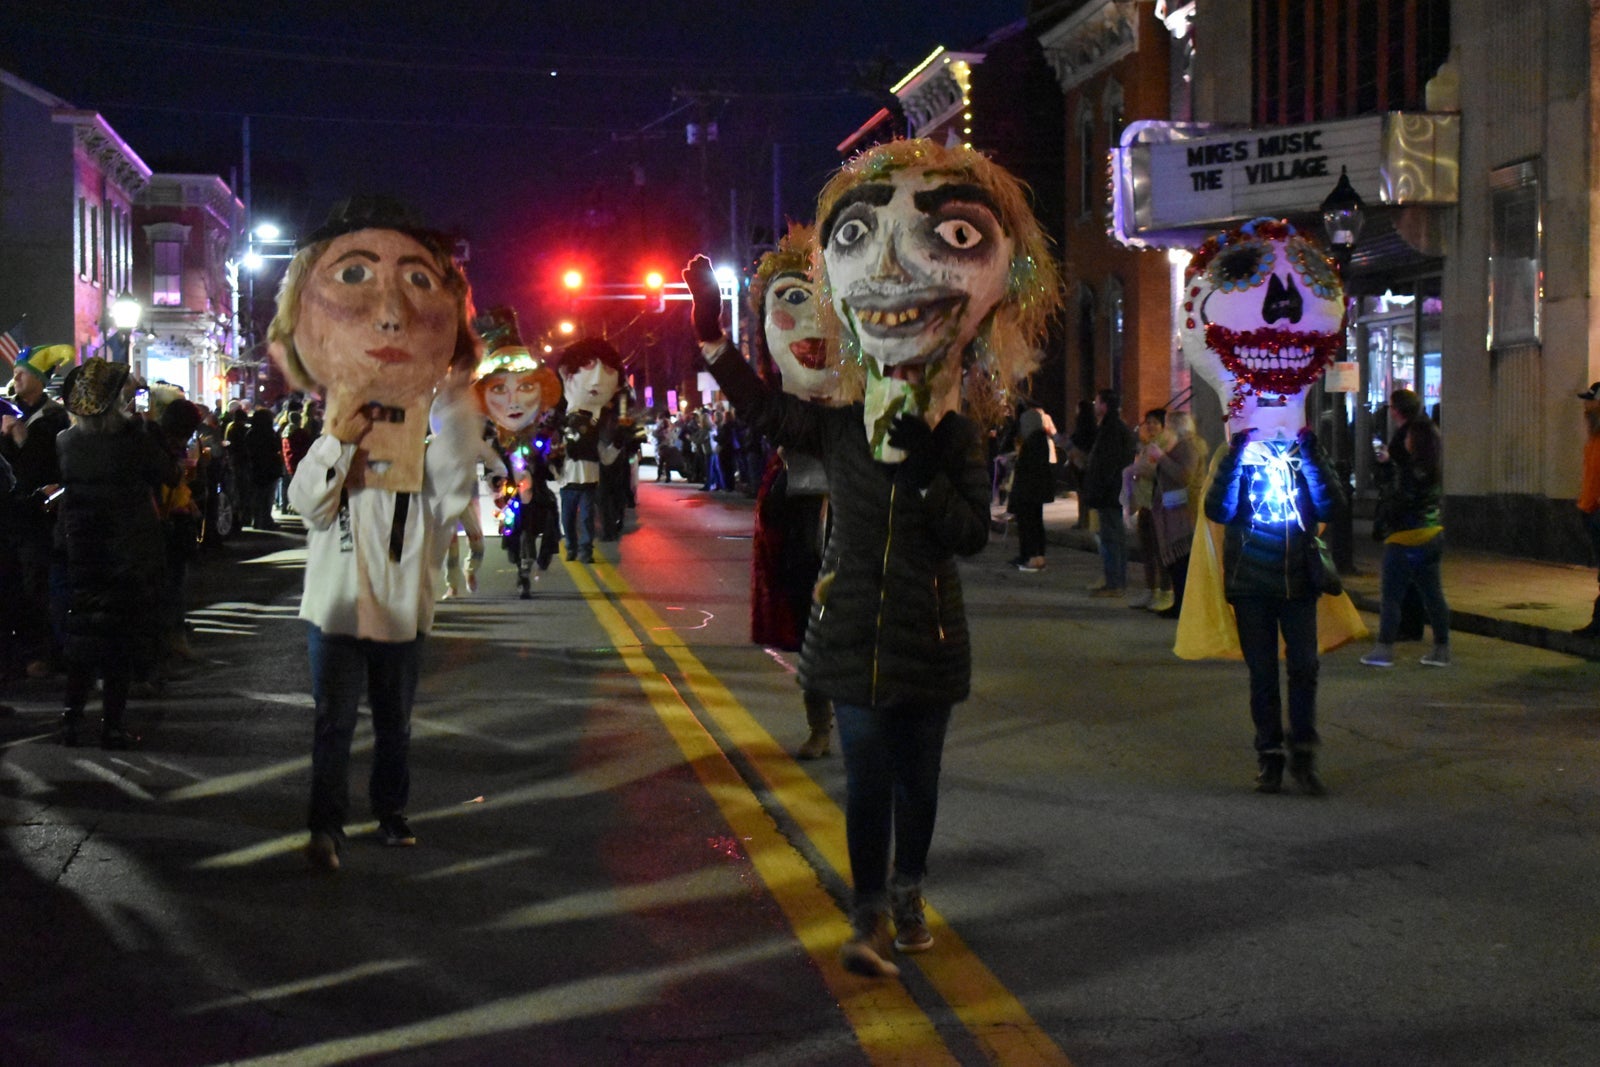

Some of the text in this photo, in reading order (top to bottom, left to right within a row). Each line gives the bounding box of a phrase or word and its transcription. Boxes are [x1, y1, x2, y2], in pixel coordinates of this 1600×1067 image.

[1187, 130, 1322, 167] MIKES MUSIC
[1190, 156, 1329, 192] THE VILLAGE
